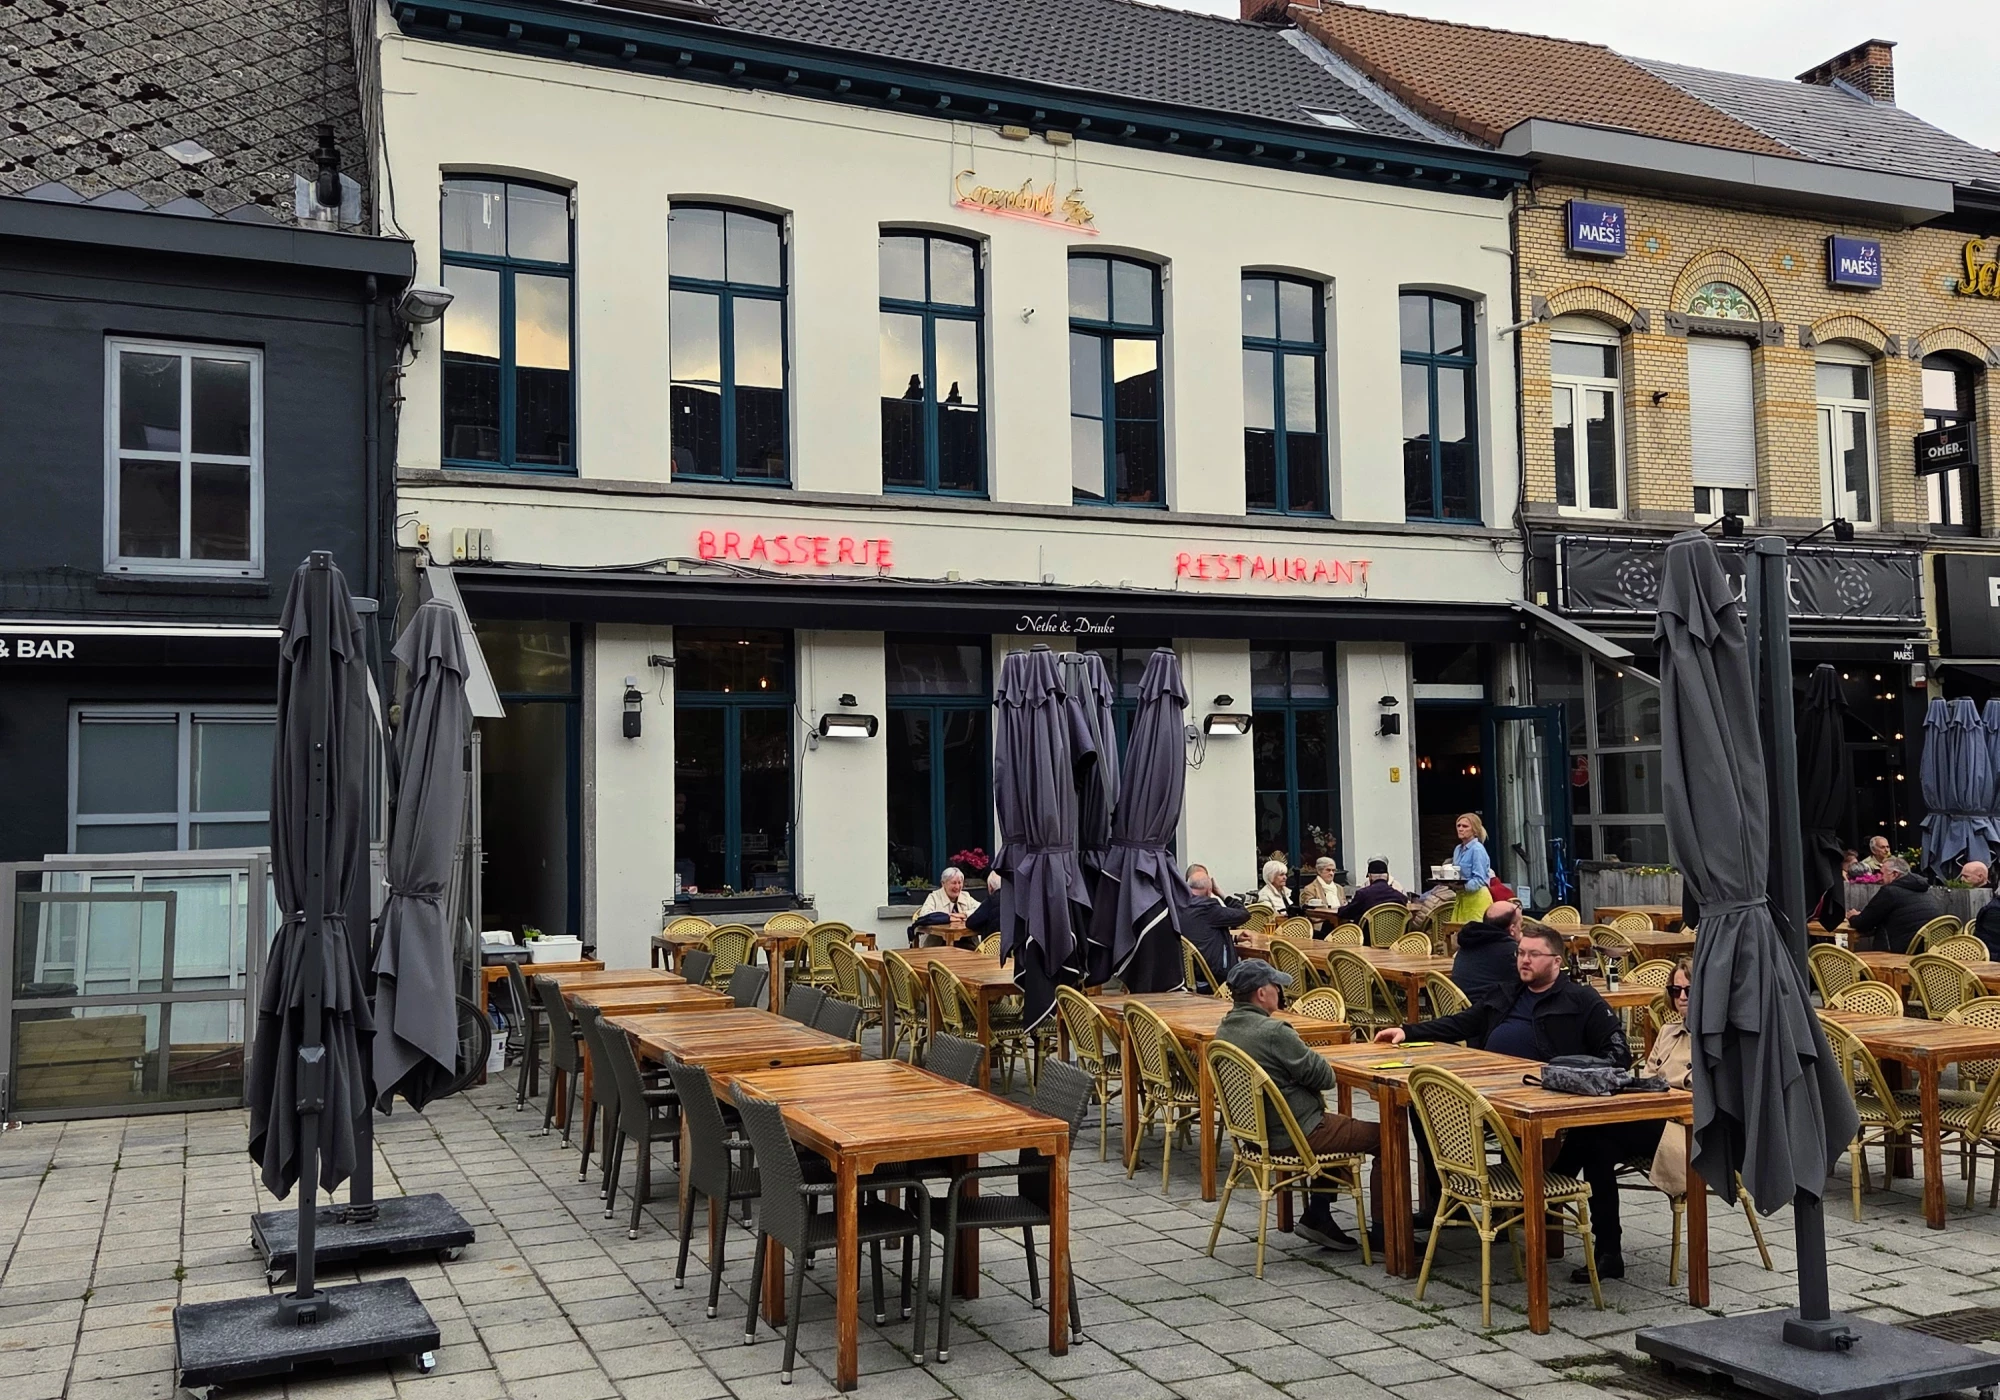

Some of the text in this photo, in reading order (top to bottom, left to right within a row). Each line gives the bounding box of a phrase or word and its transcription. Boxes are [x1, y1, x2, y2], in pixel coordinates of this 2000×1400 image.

[1579, 224, 1615, 243] MAES
[1841, 258, 1872, 275] MAES
[698, 530, 894, 567] BRASSERIE
[1176, 552, 1373, 584] RESTAURANT
[1016, 614, 1115, 633] Nethe & Drinke
[17, 639, 75, 658] BAR
